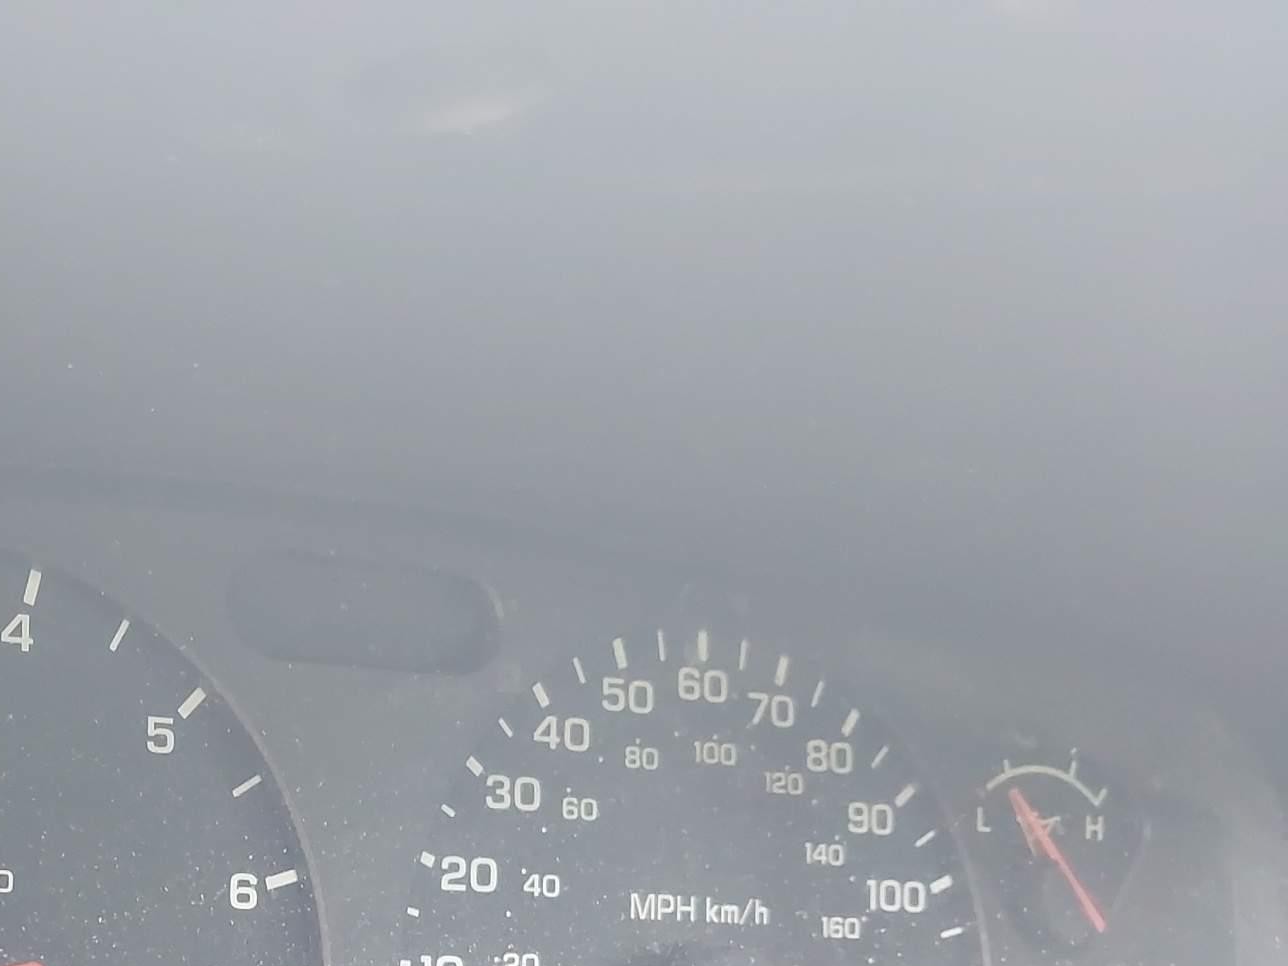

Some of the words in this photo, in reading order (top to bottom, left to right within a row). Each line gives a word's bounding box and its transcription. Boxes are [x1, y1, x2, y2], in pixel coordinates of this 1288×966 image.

[0, 613, 34, 652] 4
[601, 678, 655, 714] 50
[678, 667, 728, 703] 60
[747, 693, 795, 728] 70
[146, 716, 175, 755] 5
[533, 717, 590, 752] 40
[625, 747, 659, 770] 80
[694, 742, 736, 766] 100
[806, 739, 854, 774] 80
[486, 775, 541, 811] 30
[765, 772, 803, 796] 120
[562, 798, 598, 821] 60
[848, 802, 894, 836] 90
[977, 806, 991, 832] L
[1085, 816, 1104, 841] H
[805, 843, 844, 866] 140
[440, 856, 497, 892] 20
[523, 874, 560, 898] 40
[229, 873, 258, 909] 6
[867, 880, 925, 913] 100
[629, 894, 696, 921] MPH
[705, 896, 770, 927] km/h
[822, 917, 861, 940] 160
